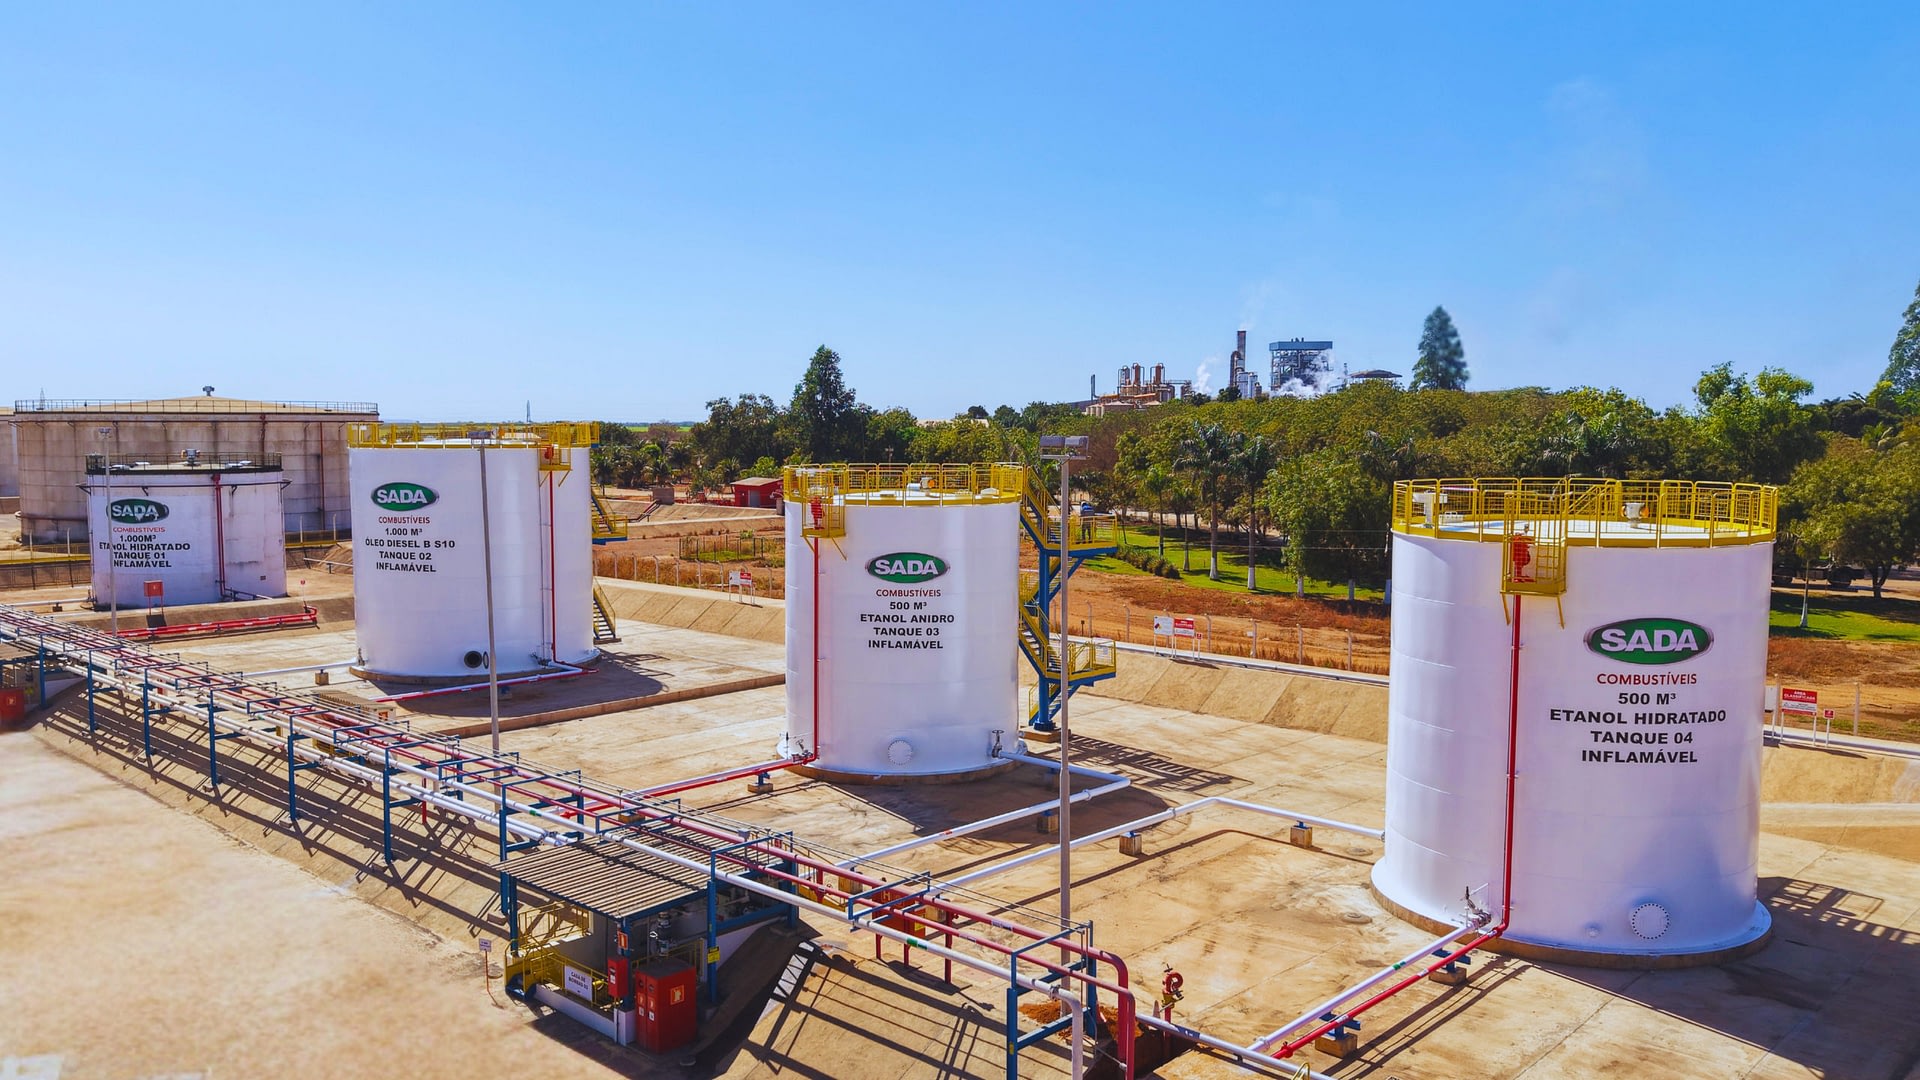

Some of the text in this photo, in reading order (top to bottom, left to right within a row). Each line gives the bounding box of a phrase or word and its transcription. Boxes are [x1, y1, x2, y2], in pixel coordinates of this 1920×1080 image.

[377, 489, 428, 504] SADA
[112, 505, 159, 517] SADA
[378, 515, 431, 524] COMBUSTÍVEIS
[385, 528, 408, 536] 1.000
[130, 543, 191, 551] HIDRATADO
[365, 536, 456, 548] ÓLEO DIESEL B S10
[379, 551, 432, 561] TANQUE 02
[114, 559, 172, 568] NFLAMÁVEL
[376, 562, 436, 573] INFLAMÁVEL
[874, 559, 939, 575] SADA
[876, 588, 941, 597] COMBUSTÍVEIS
[889, 602, 910, 610] 500
[860, 614, 955, 623] ETANOL ANIDRO
[873, 627, 940, 637] TANQUE 03
[868, 639, 943, 649] INFLAMÁVEL
[1600, 628, 1699, 652] SADA
[1596, 672, 1697, 685] COMBUSTÍVEIS
[1618, 693, 1677, 705] 500 M³
[1550, 709, 1726, 725] ETANOL HIDRATADO
[1591, 731, 1693, 745] TANQUE 04
[1582, 749, 1697, 764] INFLAMÁVEL
